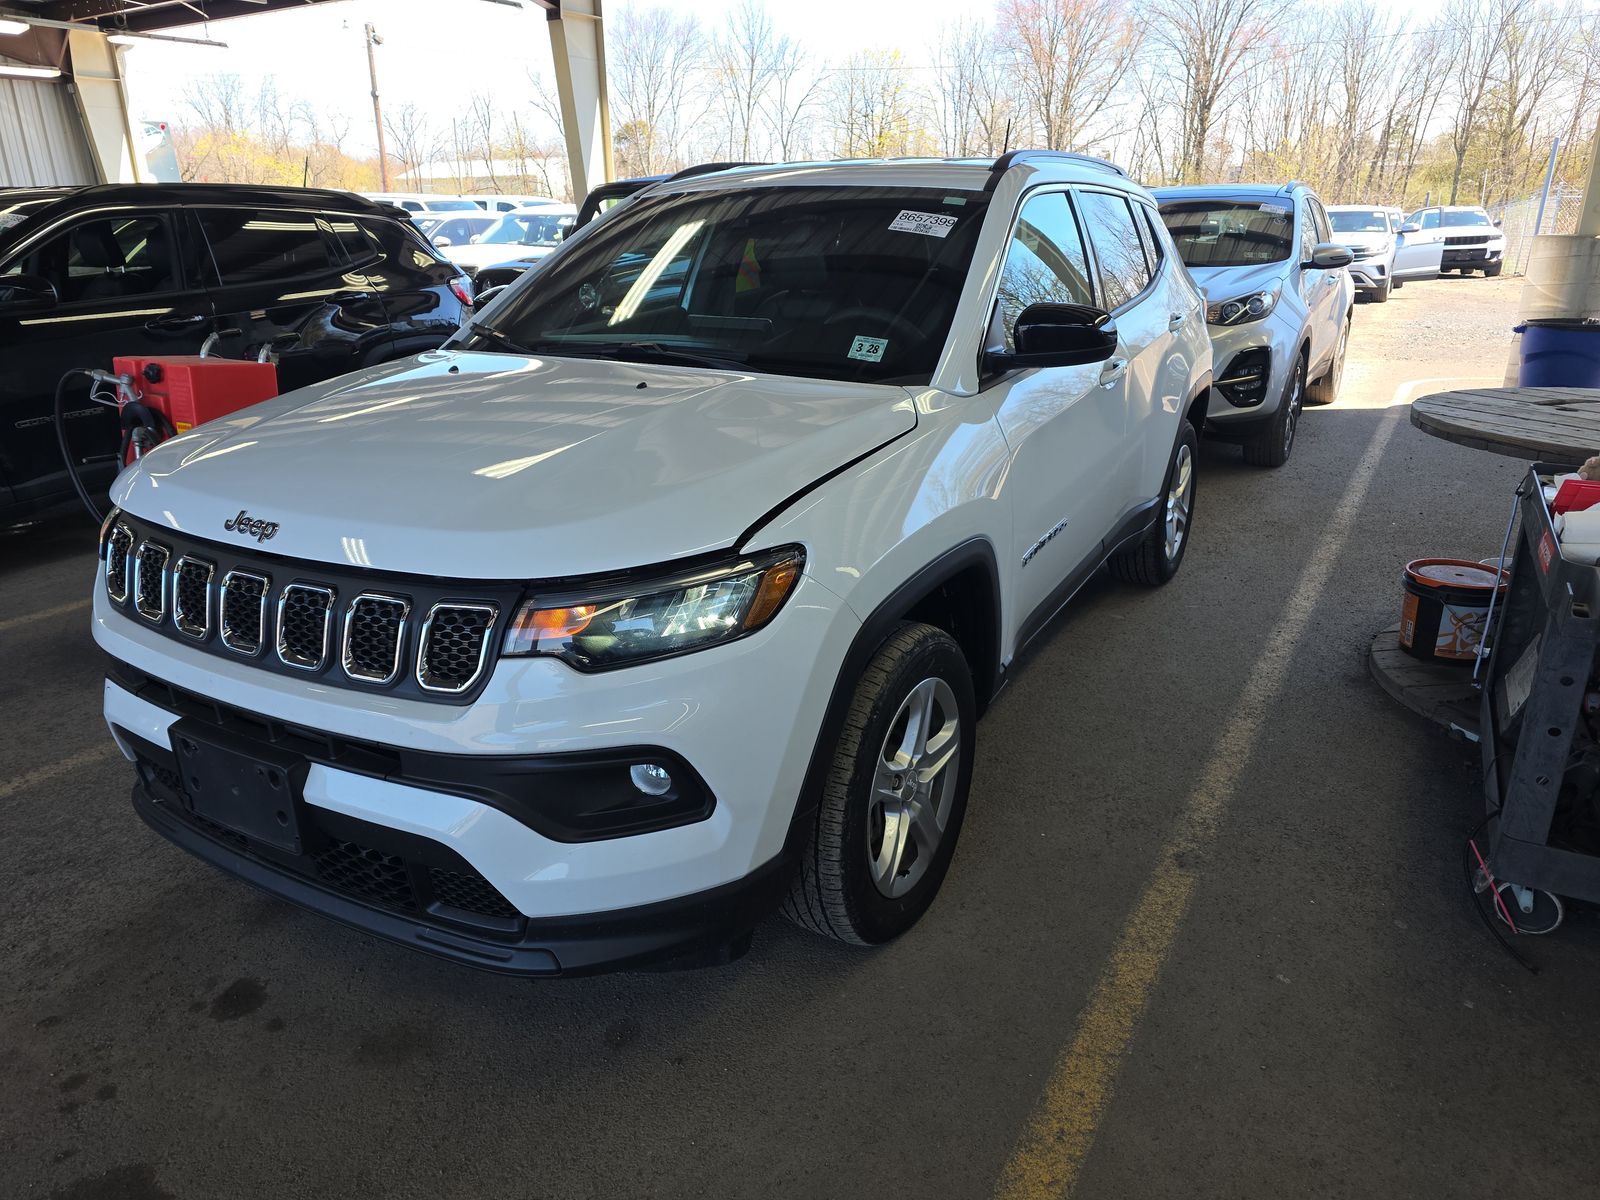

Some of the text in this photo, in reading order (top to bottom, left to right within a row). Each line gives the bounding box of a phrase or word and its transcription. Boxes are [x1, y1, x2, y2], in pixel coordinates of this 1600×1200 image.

[899, 212, 956, 227] 8657399
[856, 342, 880, 354] 3 28
[224, 510, 280, 544] Jeep
